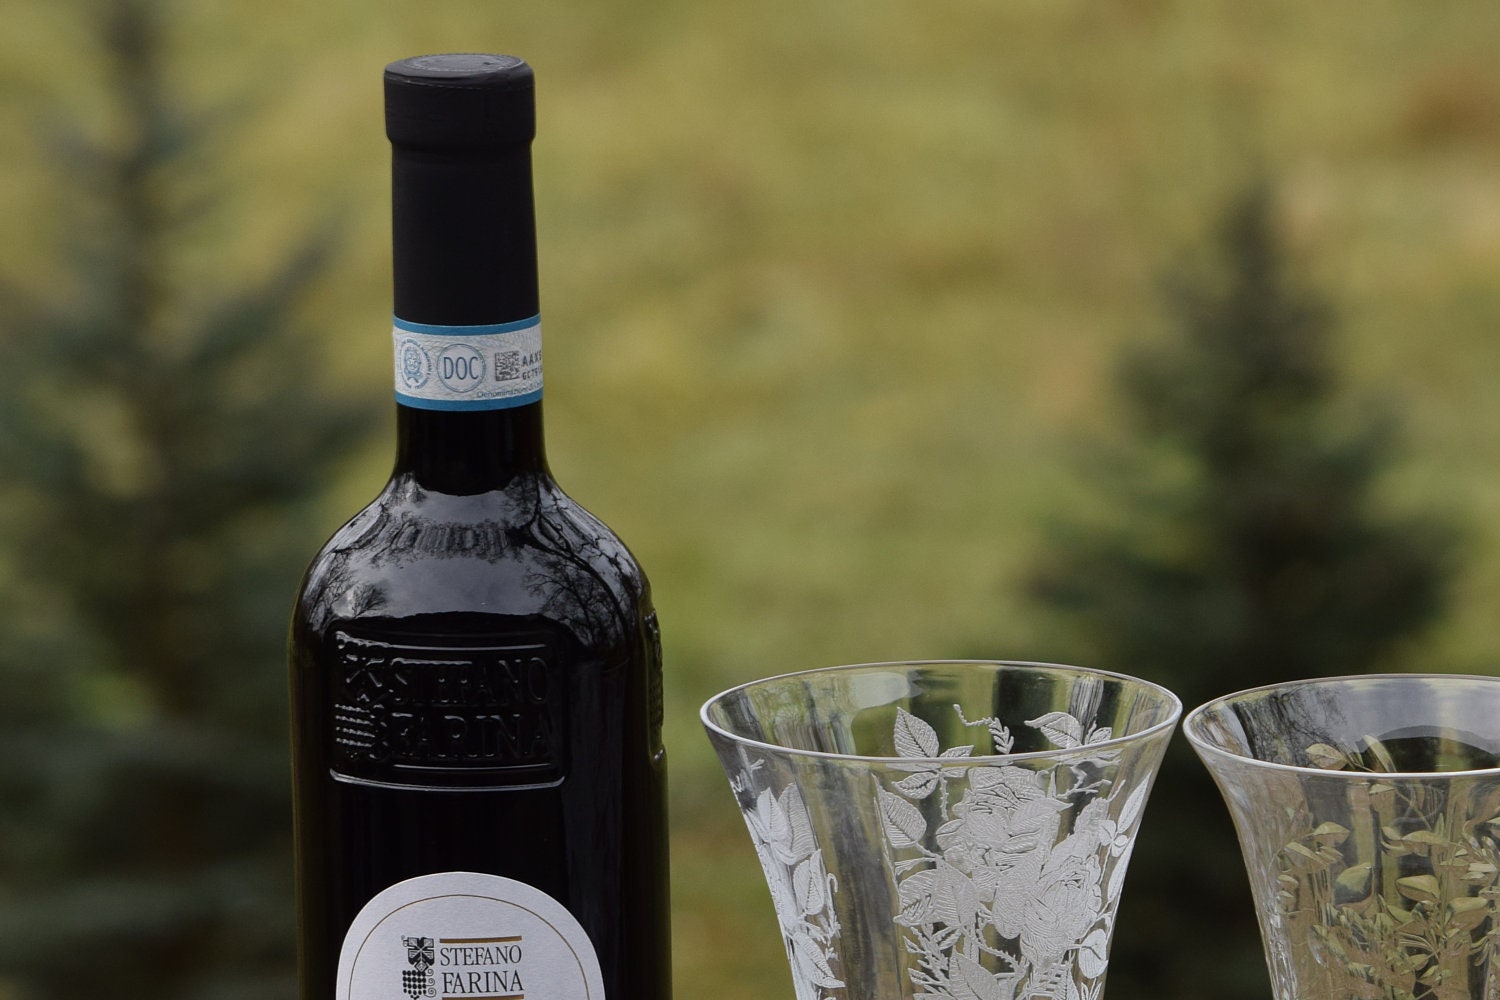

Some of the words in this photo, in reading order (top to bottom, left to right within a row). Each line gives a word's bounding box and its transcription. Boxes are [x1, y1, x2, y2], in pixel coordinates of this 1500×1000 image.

[443, 356, 479, 381] DOC
[440, 945, 522, 967] STEFANO
[441, 970, 525, 994] FARINA
